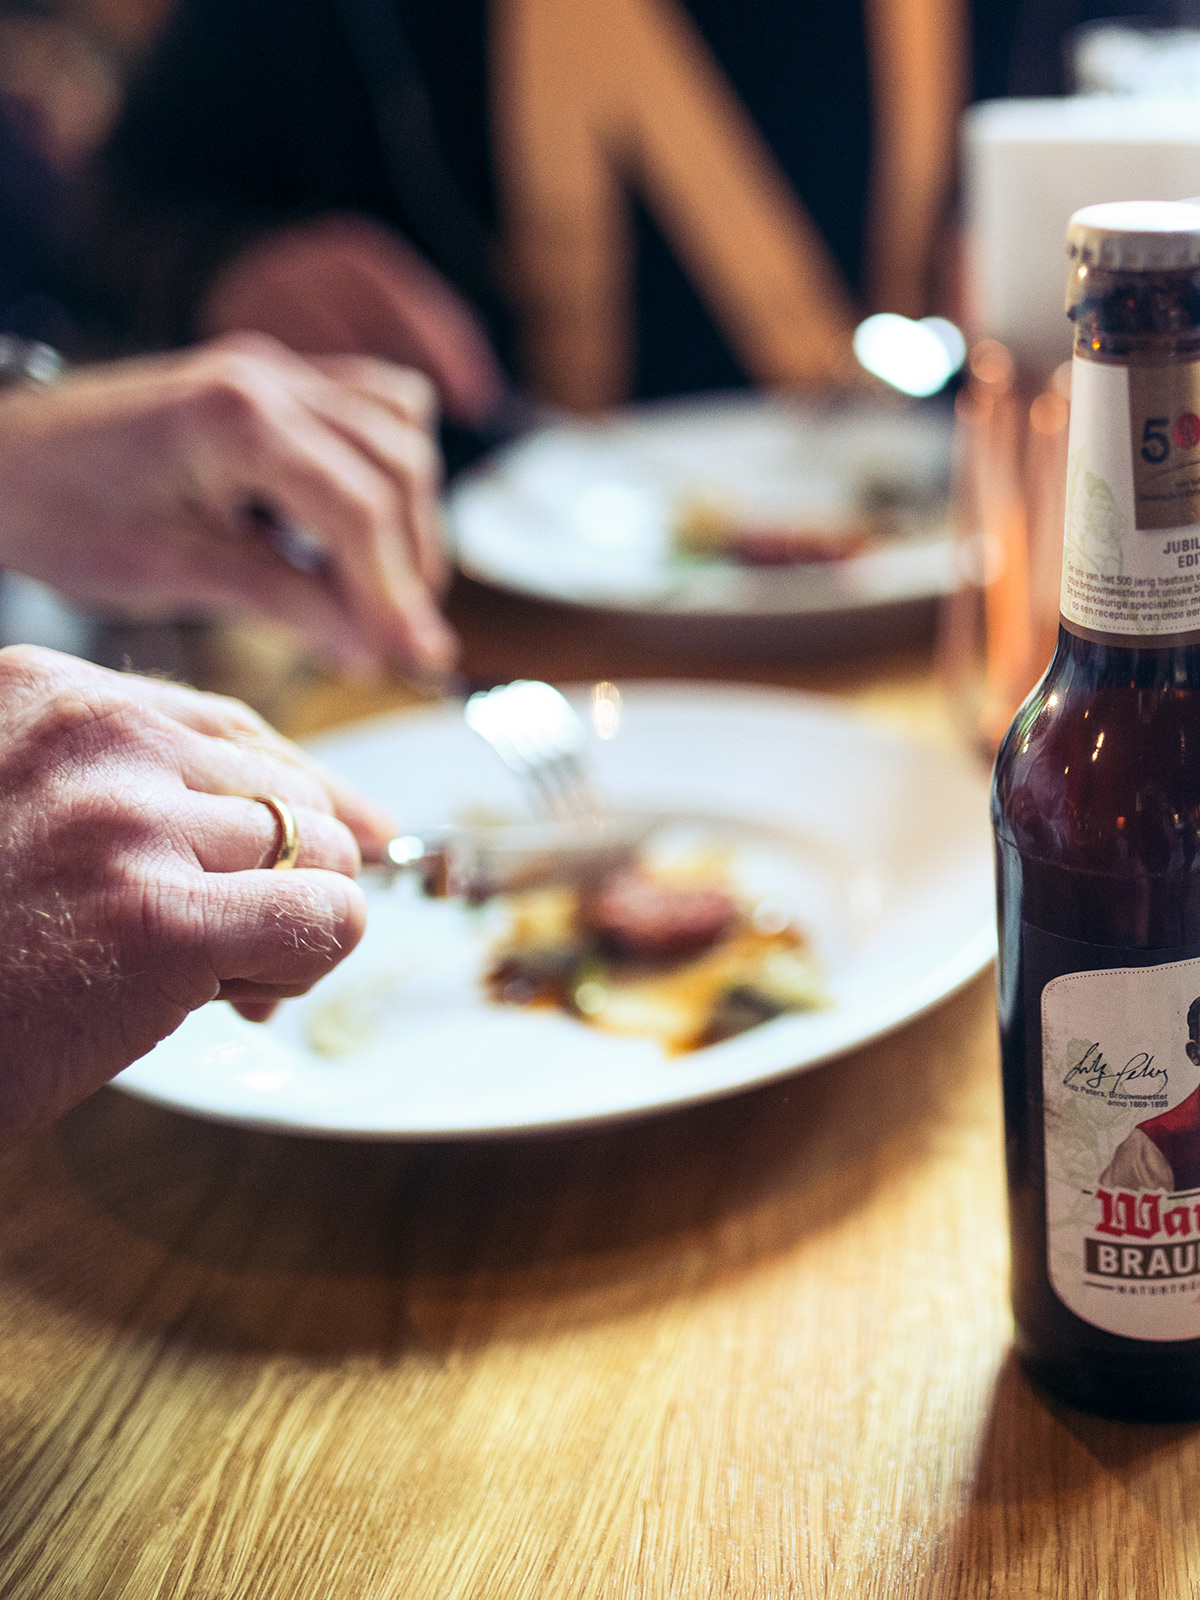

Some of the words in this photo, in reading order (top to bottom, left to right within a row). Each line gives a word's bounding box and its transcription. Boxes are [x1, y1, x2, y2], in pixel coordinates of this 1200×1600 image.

[1080, 579, 1145, 599] brouwmeesters
[1147, 588, 1160, 599] dit
[1161, 586, 1193, 598] unieke
[1086, 571, 1099, 582] van
[1101, 573, 1115, 585] het
[1116, 575, 1132, 587] 500
[1133, 577, 1156, 590] jarig
[1158, 573, 1195, 587] bestaan
[1072, 601, 1080, 612] op
[1080, 604, 1094, 615] een
[1094, 608, 1139, 621] receptuur
[1141, 613, 1160, 622] van
[1161, 610, 1184, 621] onze
[1130, 597, 1188, 612] speciaalbier
[1107, 1099, 1128, 1108] anno
